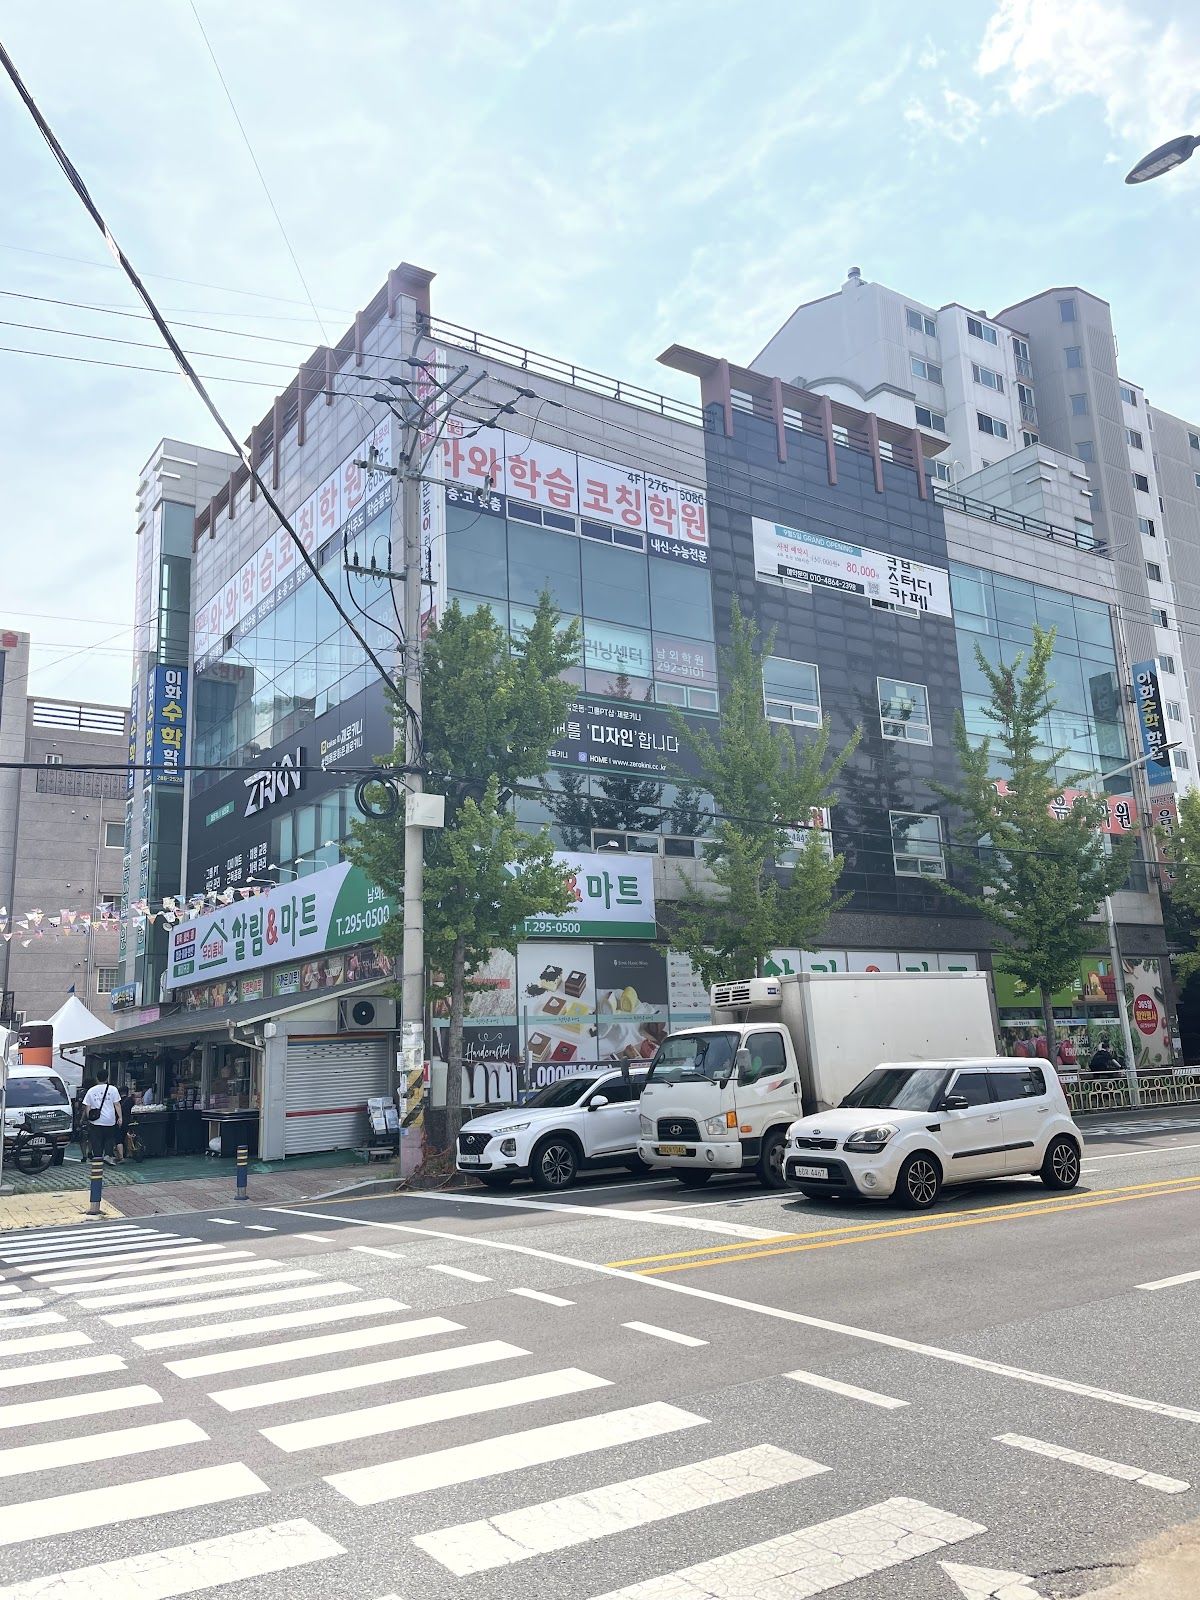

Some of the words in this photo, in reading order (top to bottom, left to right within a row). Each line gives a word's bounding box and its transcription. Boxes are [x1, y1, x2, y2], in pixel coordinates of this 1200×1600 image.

[803, 534, 825, 547] GRAND
[826, 540, 854, 554] OPENING
[888, 571, 933, 597] 스터디
[889, 587, 928, 611] 카페
[589, 754, 609, 764] HOME
[335, 904, 390, 937] T.295-0500
[524, 921, 581, 933] T.295-0500
[1069, 1035, 1089, 1045] FRESH
[465, 1041, 511, 1063] Handcrafted
[1064, 1047, 1090, 1057] PRODUCE
